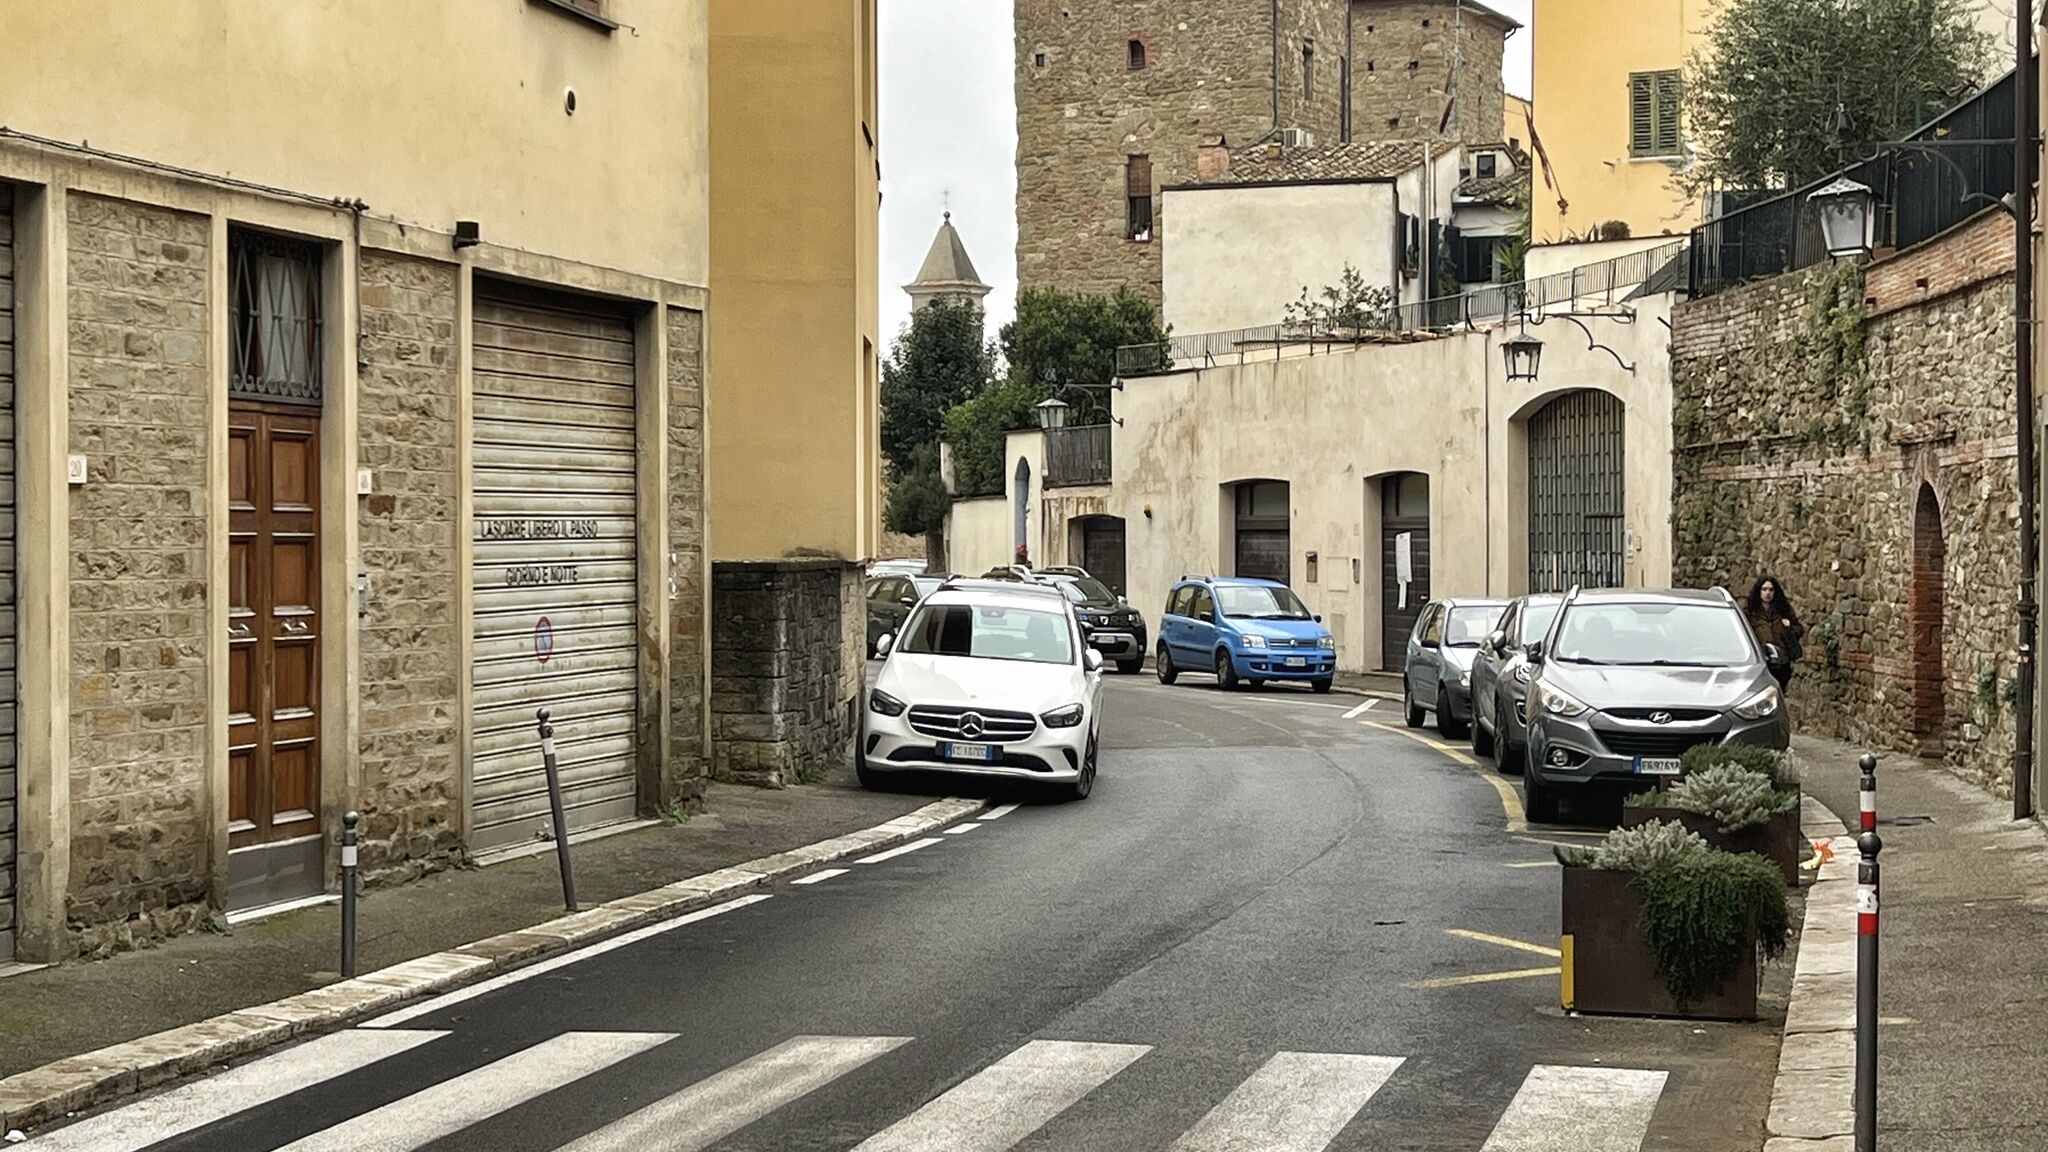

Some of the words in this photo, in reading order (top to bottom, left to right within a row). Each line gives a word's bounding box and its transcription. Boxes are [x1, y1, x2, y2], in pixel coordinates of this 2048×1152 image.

[69, 460, 82, 477] 20
[480, 520, 526, 538] LASCIARE
[528, 520, 560, 537] LIBERO
[561, 520, 569, 538] IL
[570, 520, 599, 538] PASSO
[505, 566, 541, 585] GIORNO
[542, 567, 548, 582] E
[550, 566, 578, 582] NOTTE
